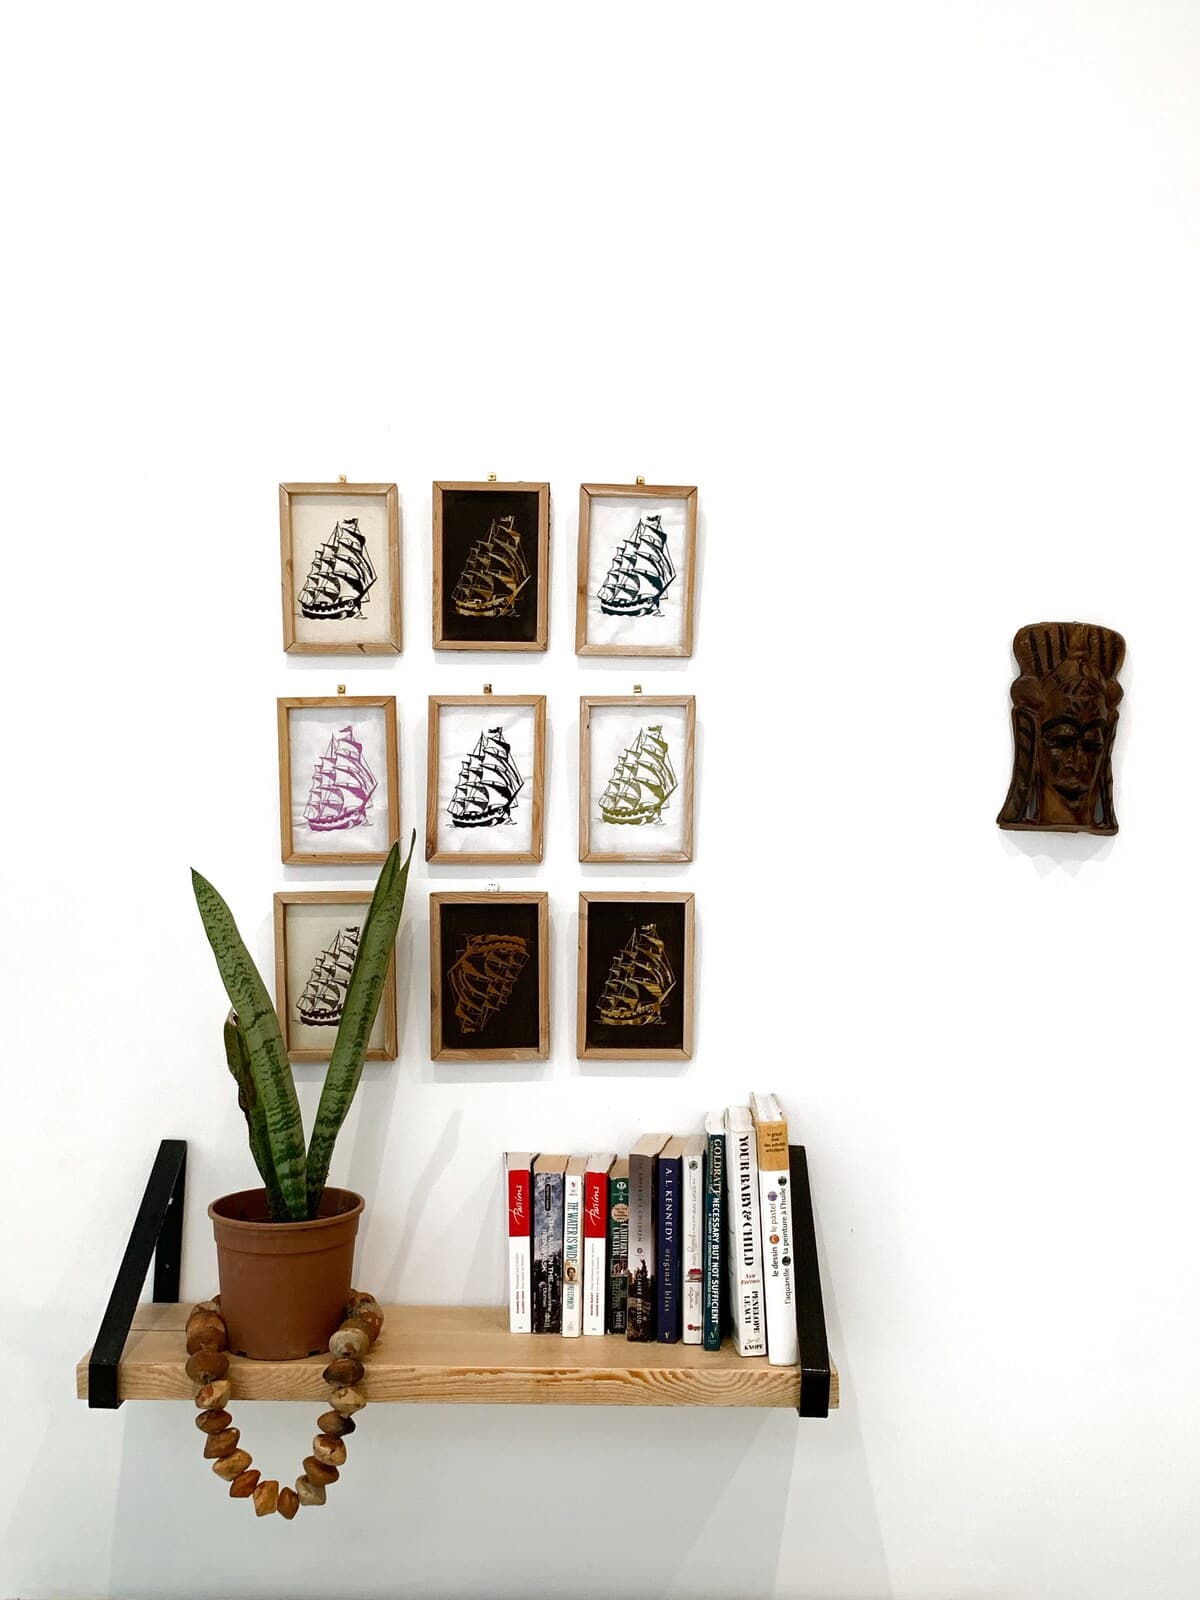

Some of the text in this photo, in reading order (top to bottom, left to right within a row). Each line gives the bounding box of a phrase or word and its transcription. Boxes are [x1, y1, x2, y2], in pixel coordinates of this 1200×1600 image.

[713, 1139, 722, 1195] GOLDRATT
[739, 1135, 750, 1171] YOUR
[665, 1168, 672, 1177] A.
[567, 1202, 579, 1212] THE
[769, 1203, 777, 1233] le pastel
[567, 1212, 579, 1235] WATER
[781, 1216, 789, 1246] peinture
[567, 1244, 578, 1263] WIDE
[613, 1227, 621, 1256] COULTER
[712, 1245, 720, 1260] BUT
[781, 1247, 788, 1255] la
[663, 1249, 671, 1286] original
[771, 1247, 779, 1269] dessin
[783, 1268, 792, 1305] l'aquarelle
[711, 1280, 719, 1324] SUFFICIENT
[744, 1295, 752, 1324] LEACH
[751, 1290, 760, 1334] PENELOPE
